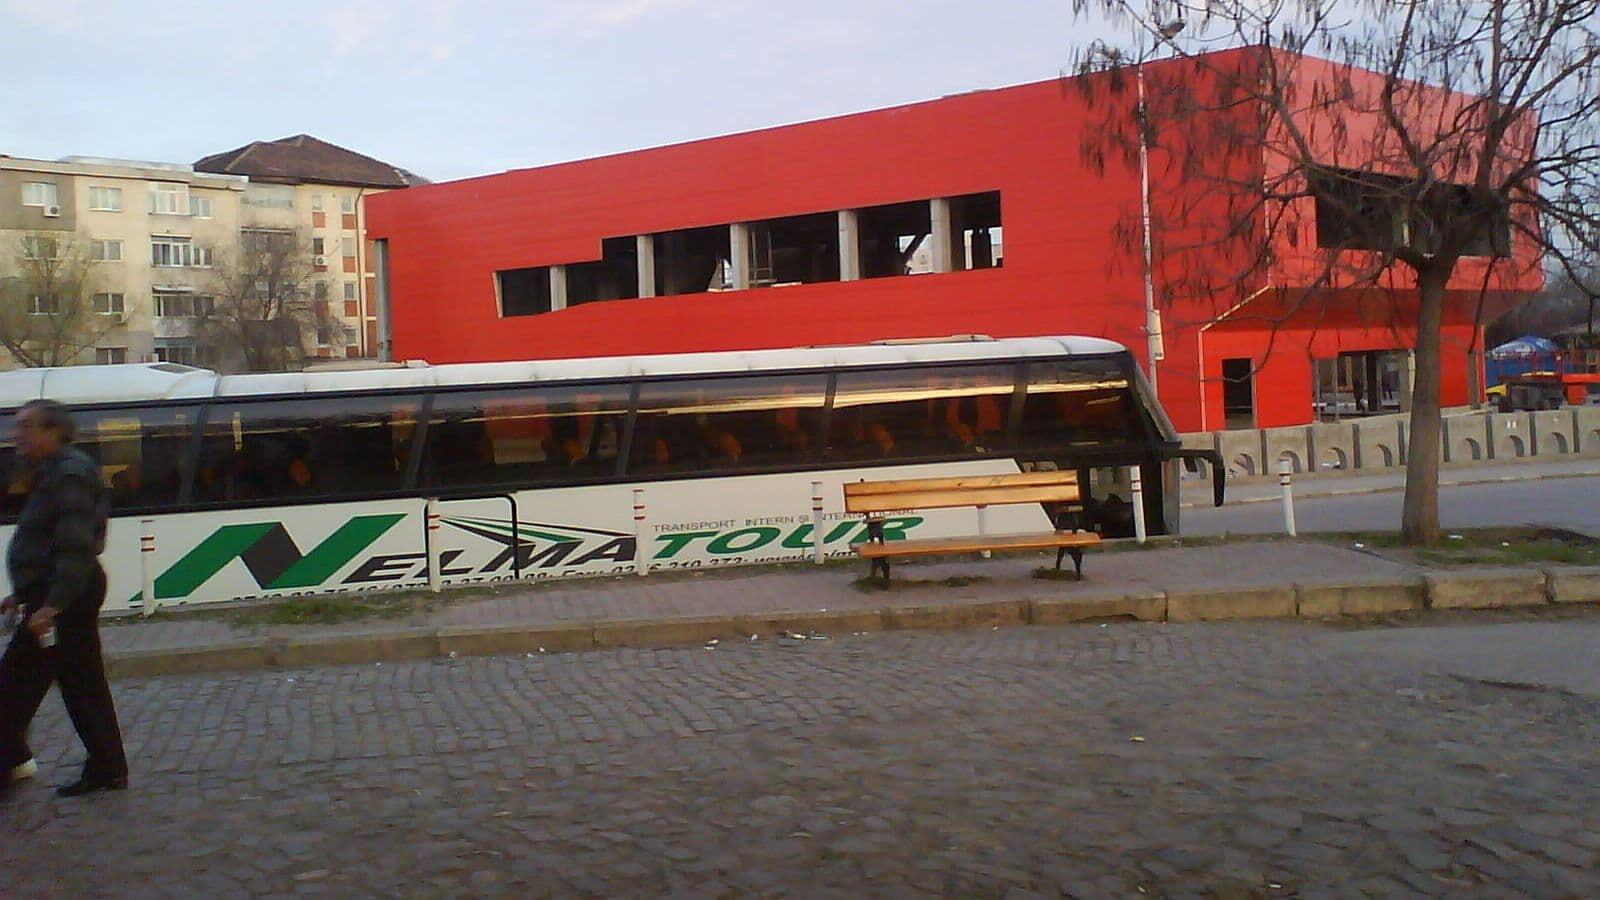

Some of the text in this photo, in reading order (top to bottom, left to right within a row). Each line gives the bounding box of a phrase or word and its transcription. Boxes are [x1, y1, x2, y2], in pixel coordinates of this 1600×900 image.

[653, 520, 737, 532] TRANSPORT
[745, 516, 794, 527] INTERN
[129, 513, 925, 601] NELMA TOUR
